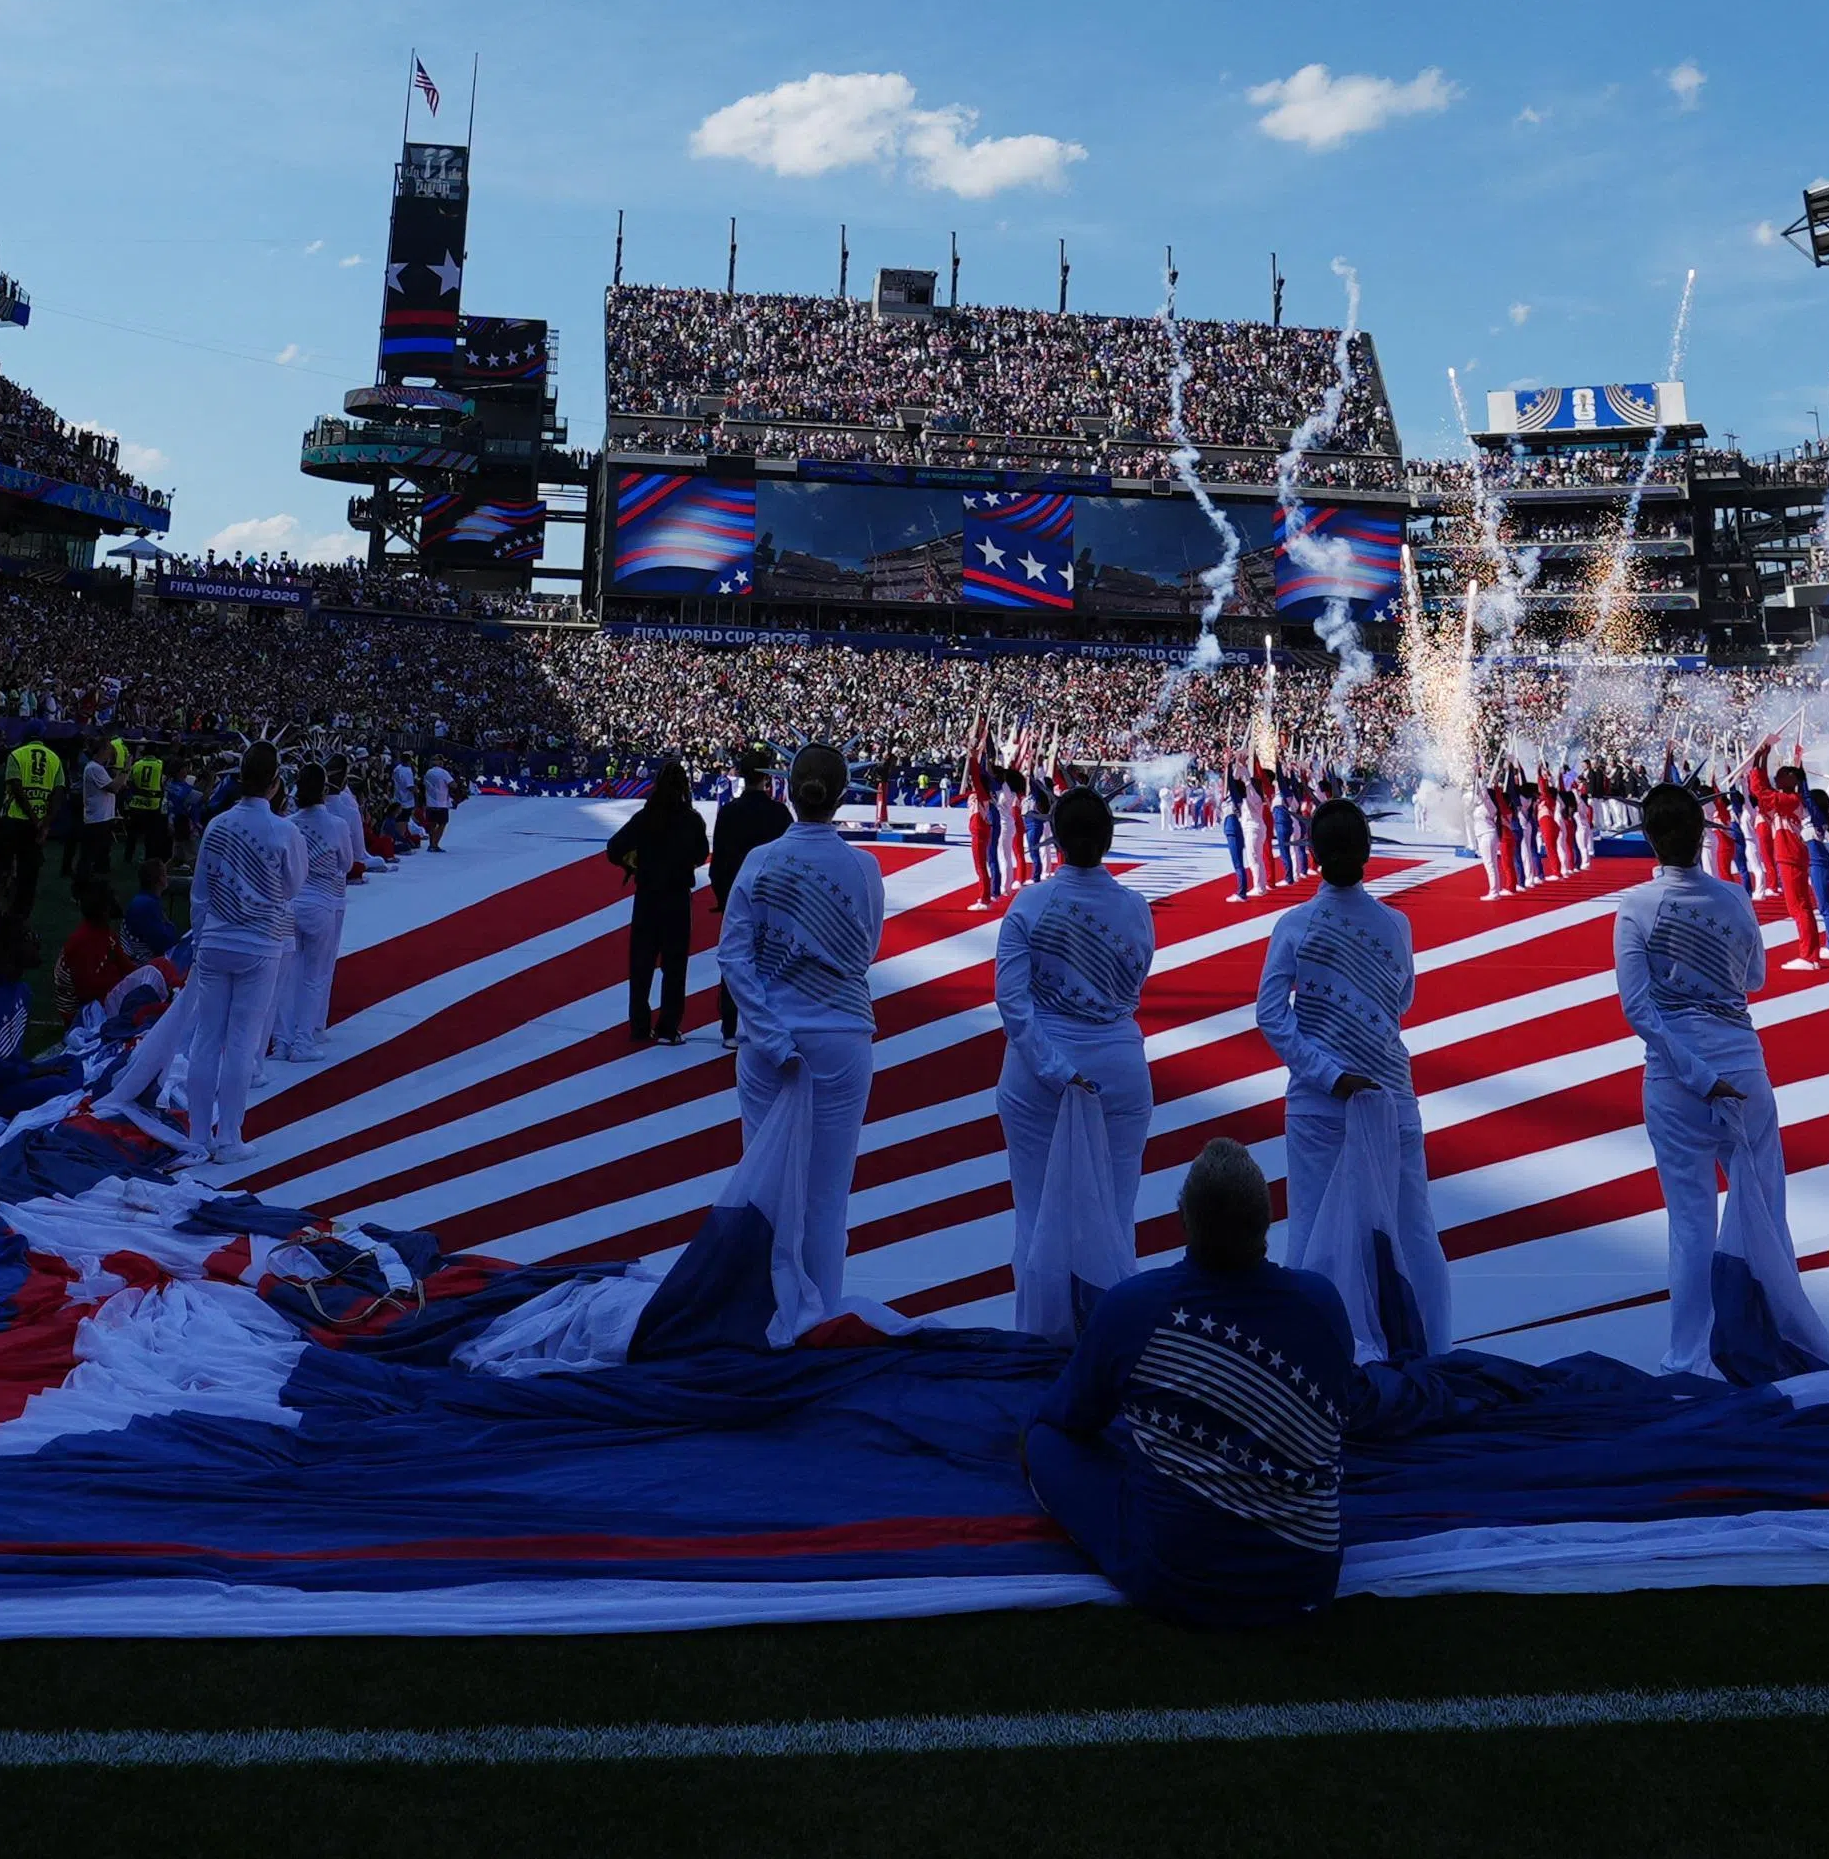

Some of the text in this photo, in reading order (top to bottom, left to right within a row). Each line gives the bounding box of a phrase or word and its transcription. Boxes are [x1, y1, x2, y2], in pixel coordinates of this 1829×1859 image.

[170, 580, 301, 603] FIFA WORLD CUP 2026
[632, 627, 811, 645] FIFA WORLD CUP 2026
[1080, 645, 1112, 658] FIFA
[1537, 656, 1680, 668] PHILADELPHIA
